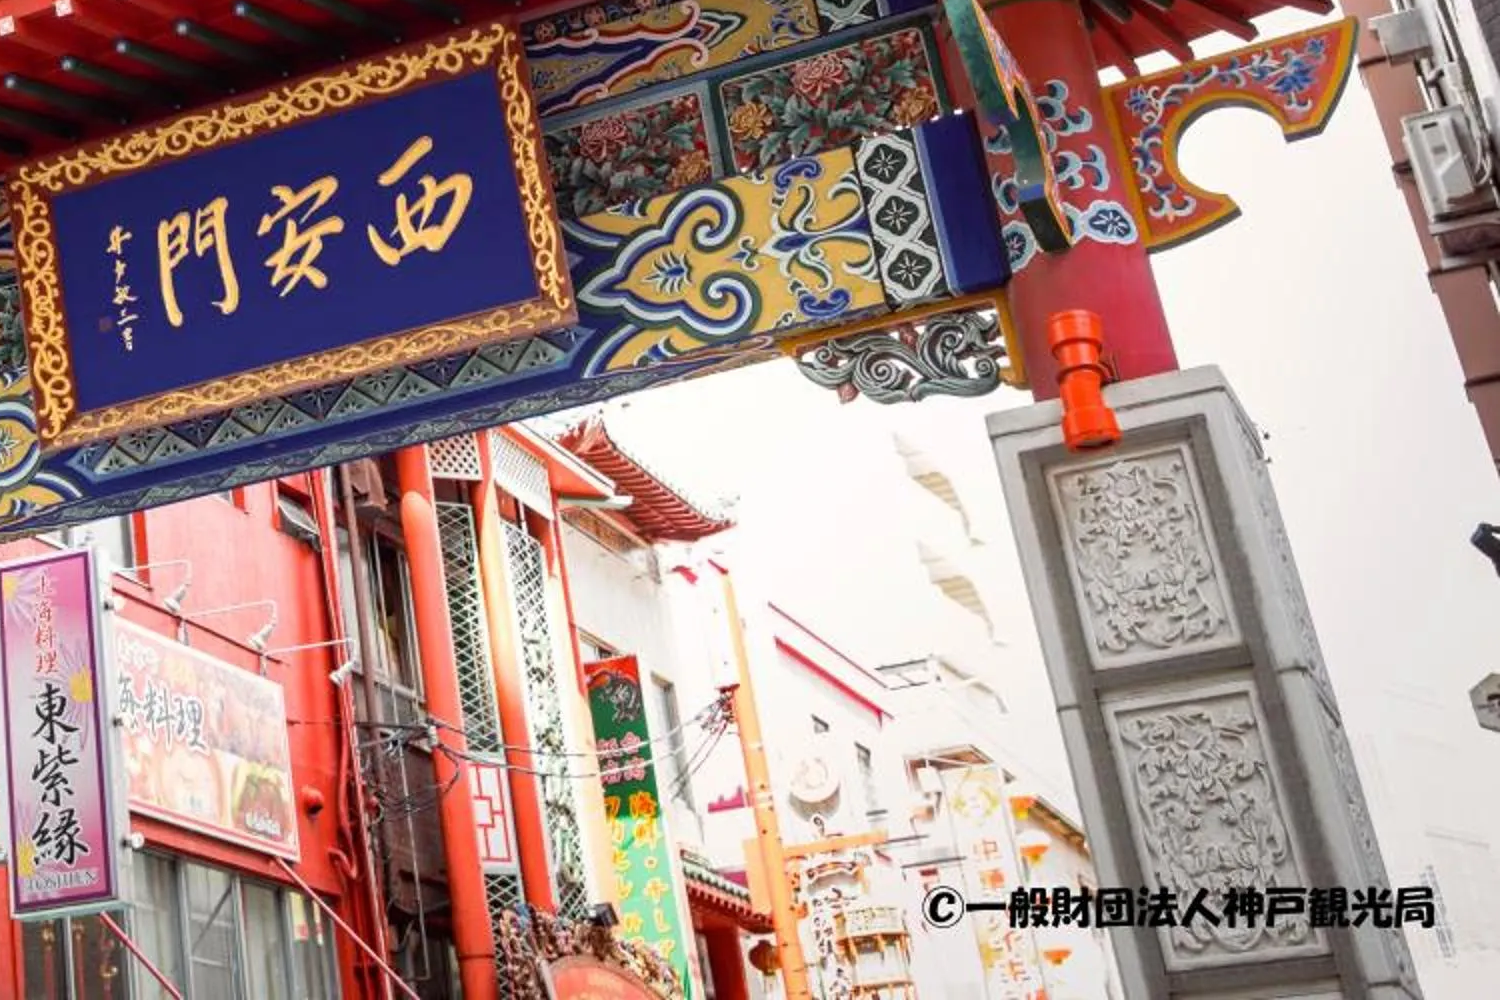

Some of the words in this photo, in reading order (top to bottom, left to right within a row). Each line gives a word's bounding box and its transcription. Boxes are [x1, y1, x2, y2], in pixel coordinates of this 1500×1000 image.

[34, 571, 60, 675] 上海料理
[30, 683, 90, 866] 東紫縁
